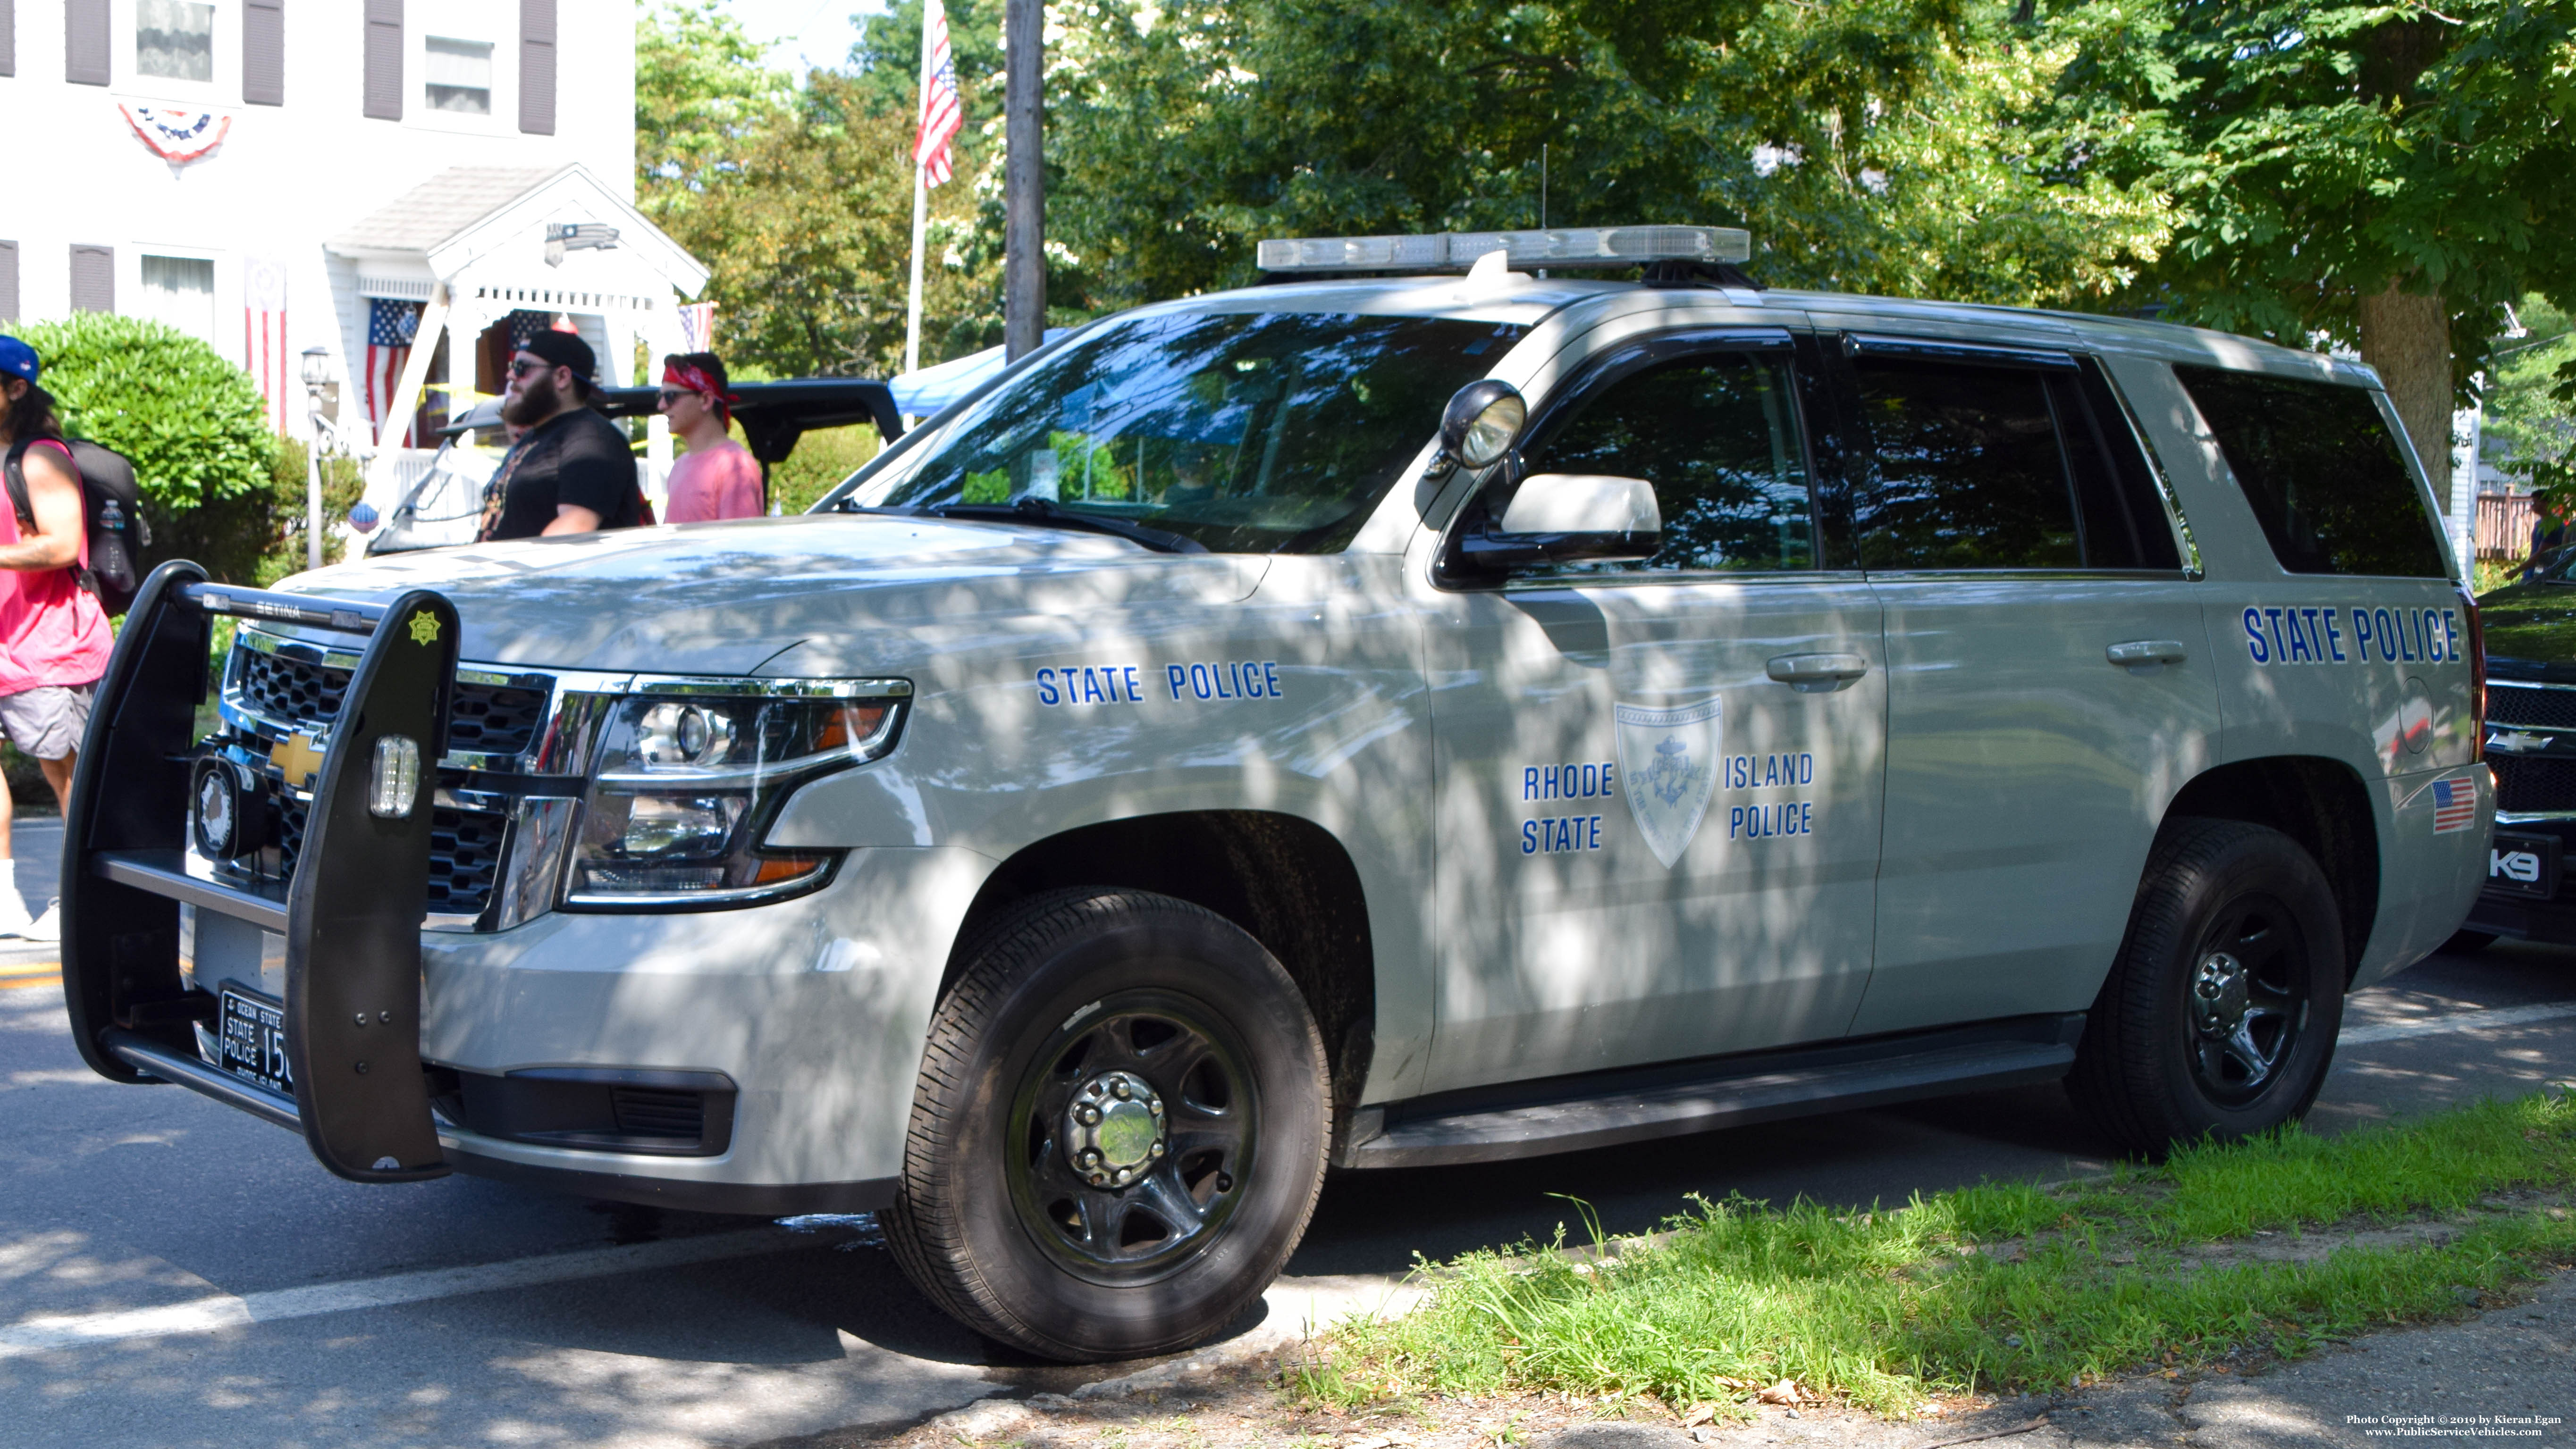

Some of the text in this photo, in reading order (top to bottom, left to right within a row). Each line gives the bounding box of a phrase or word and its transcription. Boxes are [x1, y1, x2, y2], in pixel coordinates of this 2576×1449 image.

[256, 601, 301, 619] SETINA
[2243, 607, 2460, 663] STATE POLICE
[1035, 662, 1283, 706] STATE POLICE
[1522, 753, 1813, 801] RHODE ISLAND
[1521, 815, 1602, 855] STATE
[1729, 803, 1812, 839] POLICE
[2489, 848, 2539, 882] K9
[227, 1016, 254, 1043] STATE
[237, 1001, 281, 1030] OCEAN STATE
[225, 1037, 257, 1066] POLICE
